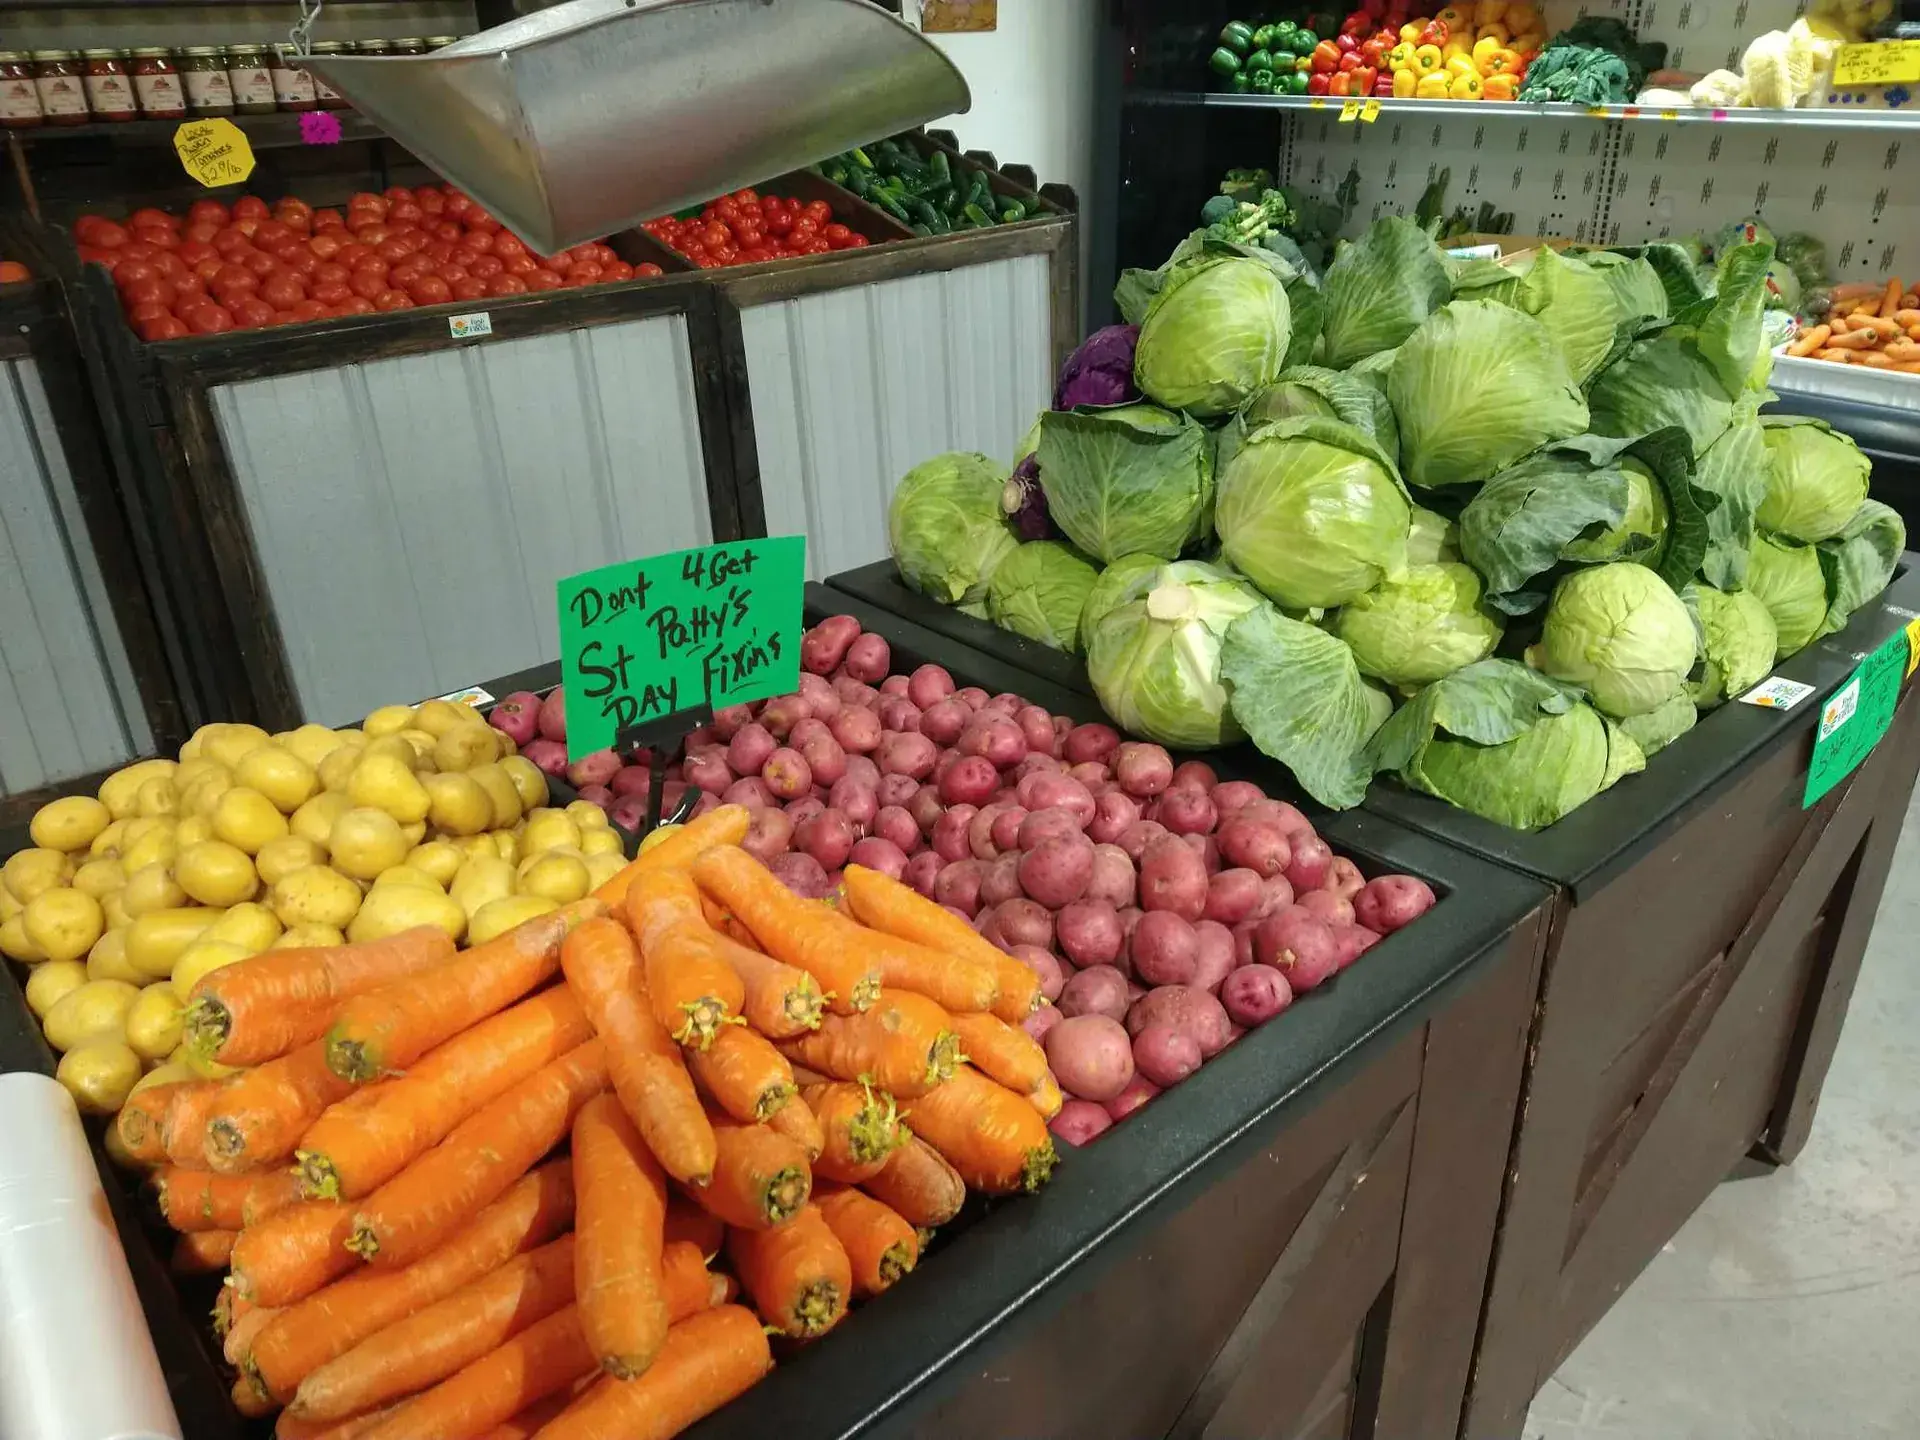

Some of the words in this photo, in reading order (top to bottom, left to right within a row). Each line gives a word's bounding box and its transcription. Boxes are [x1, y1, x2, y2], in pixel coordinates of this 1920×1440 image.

[570, 571, 653, 628] Dont
[578, 641, 635, 698] St
[646, 585, 752, 659] Patty's
